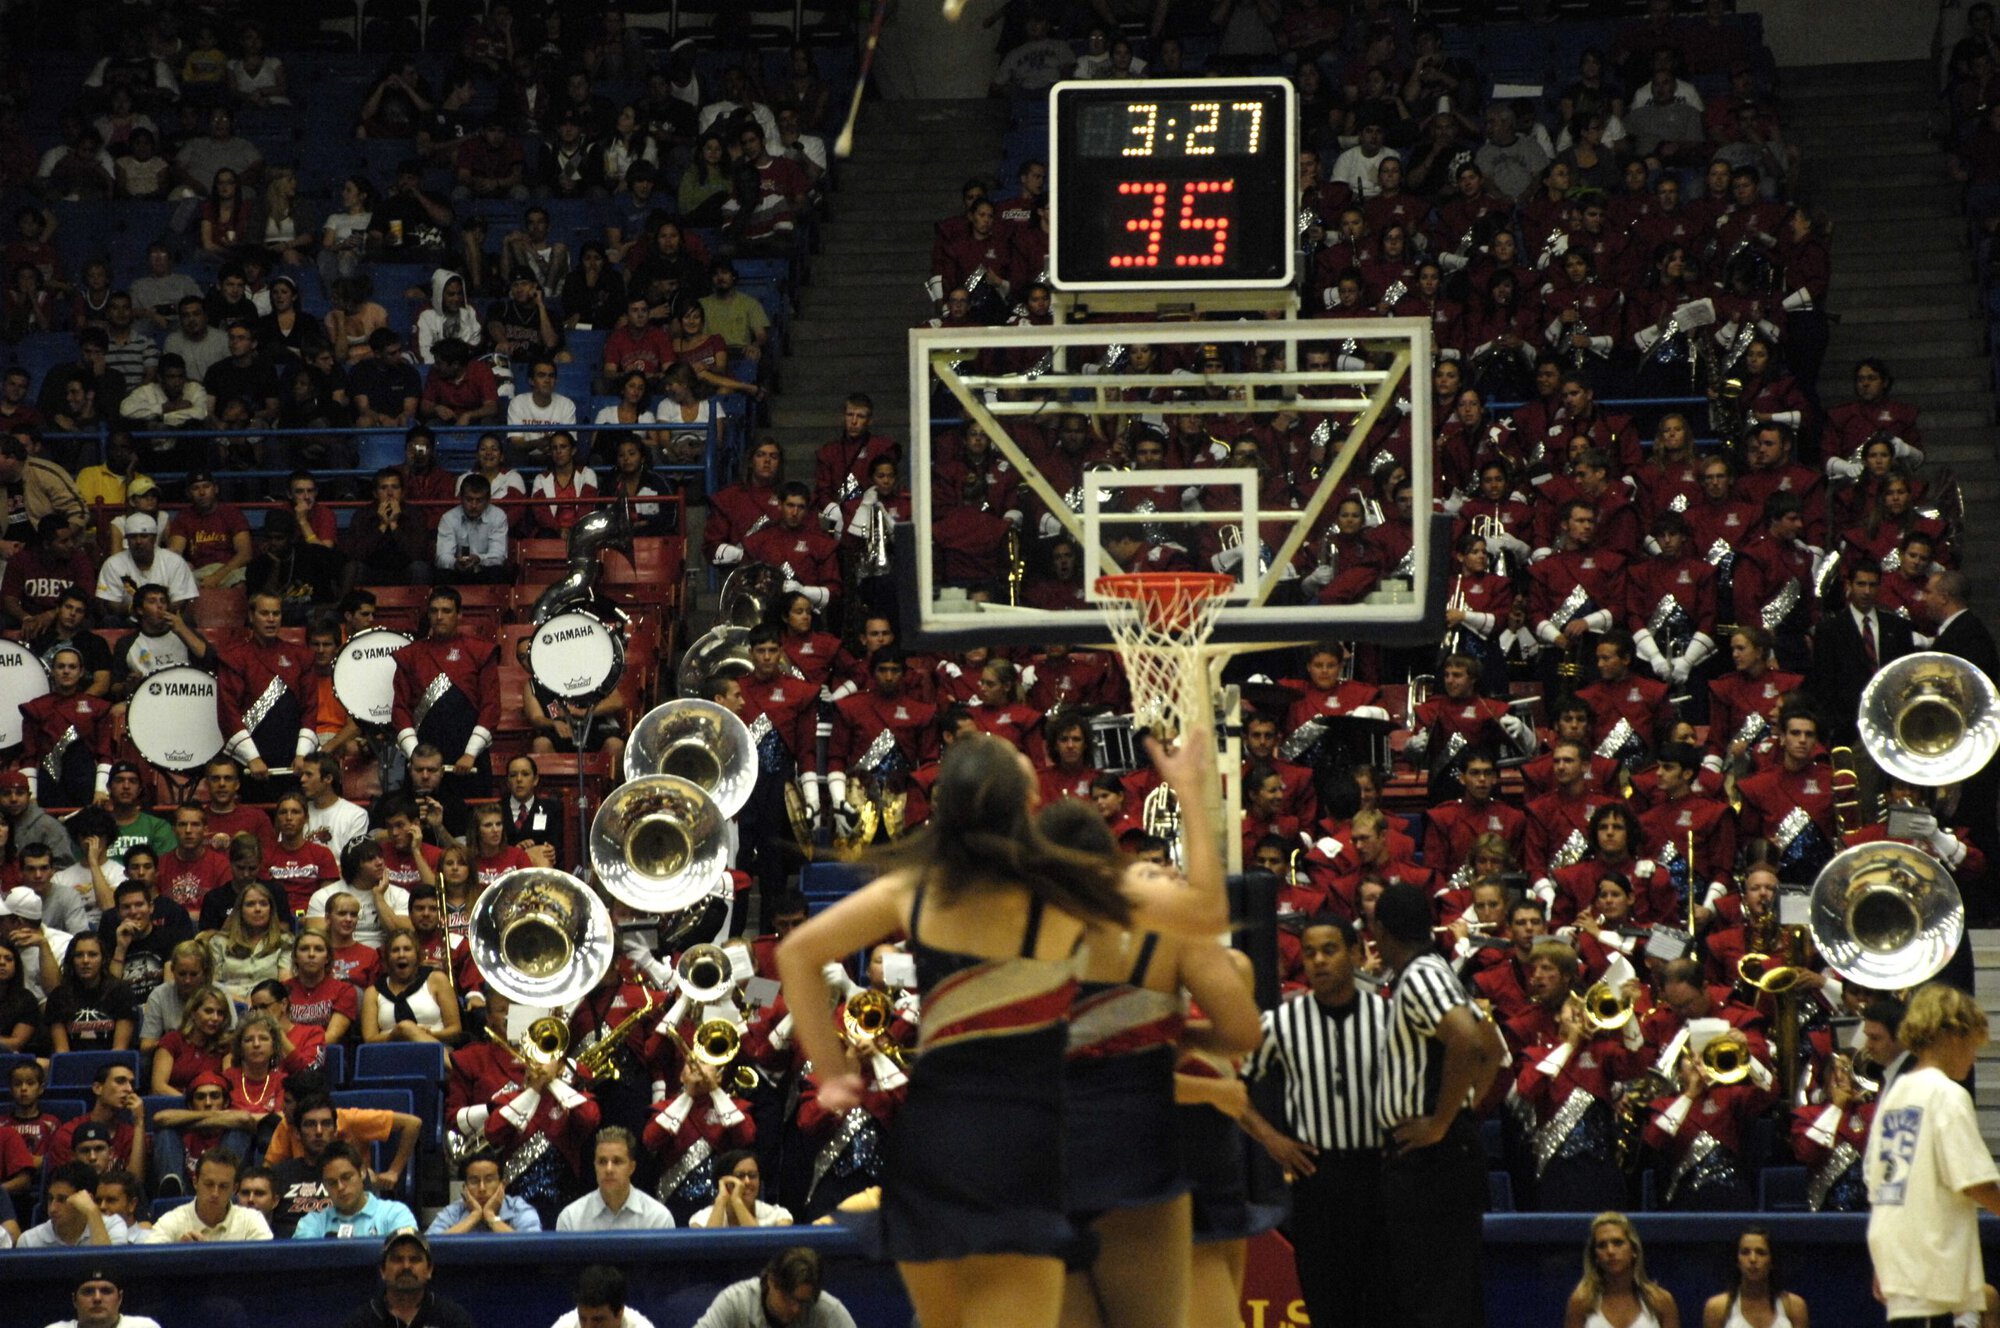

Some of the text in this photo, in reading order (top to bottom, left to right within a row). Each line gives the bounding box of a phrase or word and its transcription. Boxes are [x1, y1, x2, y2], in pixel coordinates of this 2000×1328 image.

[1122, 102, 1262, 154] 3:27
[1109, 181, 1234, 266] 35
[554, 625, 594, 643] YAMAHA
[165, 683, 213, 697] YAMAHA
[287, 1198, 333, 1213] ZOO
